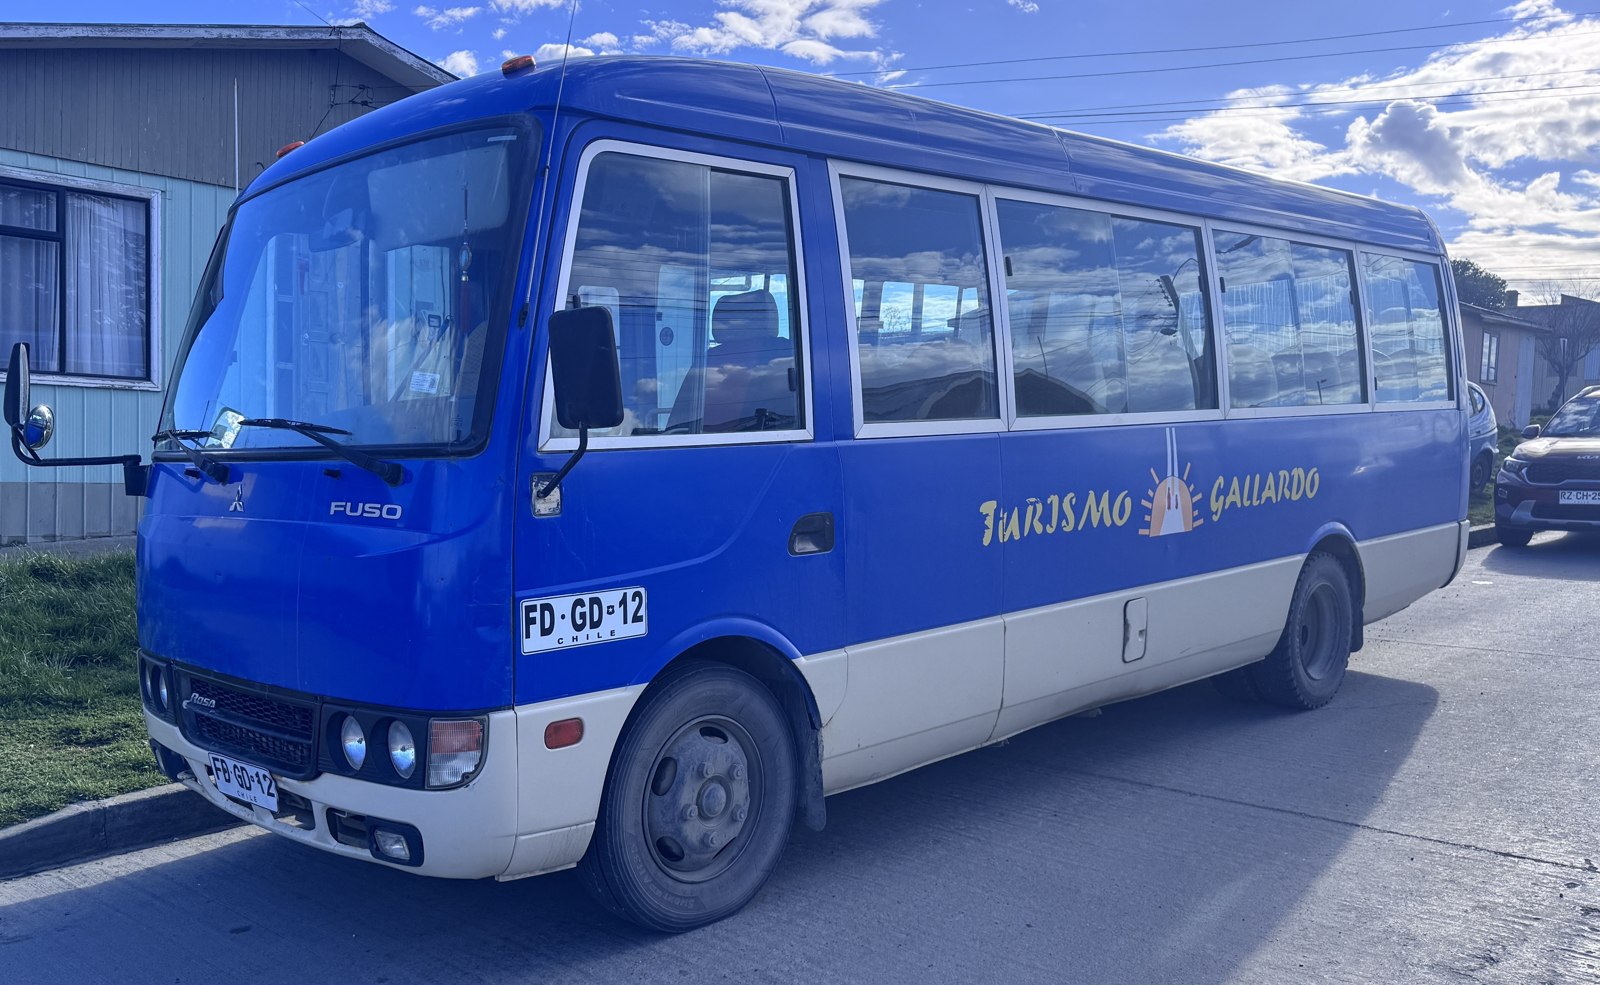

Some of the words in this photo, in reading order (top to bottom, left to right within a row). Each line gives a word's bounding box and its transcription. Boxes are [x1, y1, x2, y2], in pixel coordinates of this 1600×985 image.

[329, 501, 402, 520] FUSO
[979, 489, 1133, 547] TURISMO
[1210, 466, 1320, 522] GALLARDO
[557, 629, 616, 645] CHILE
